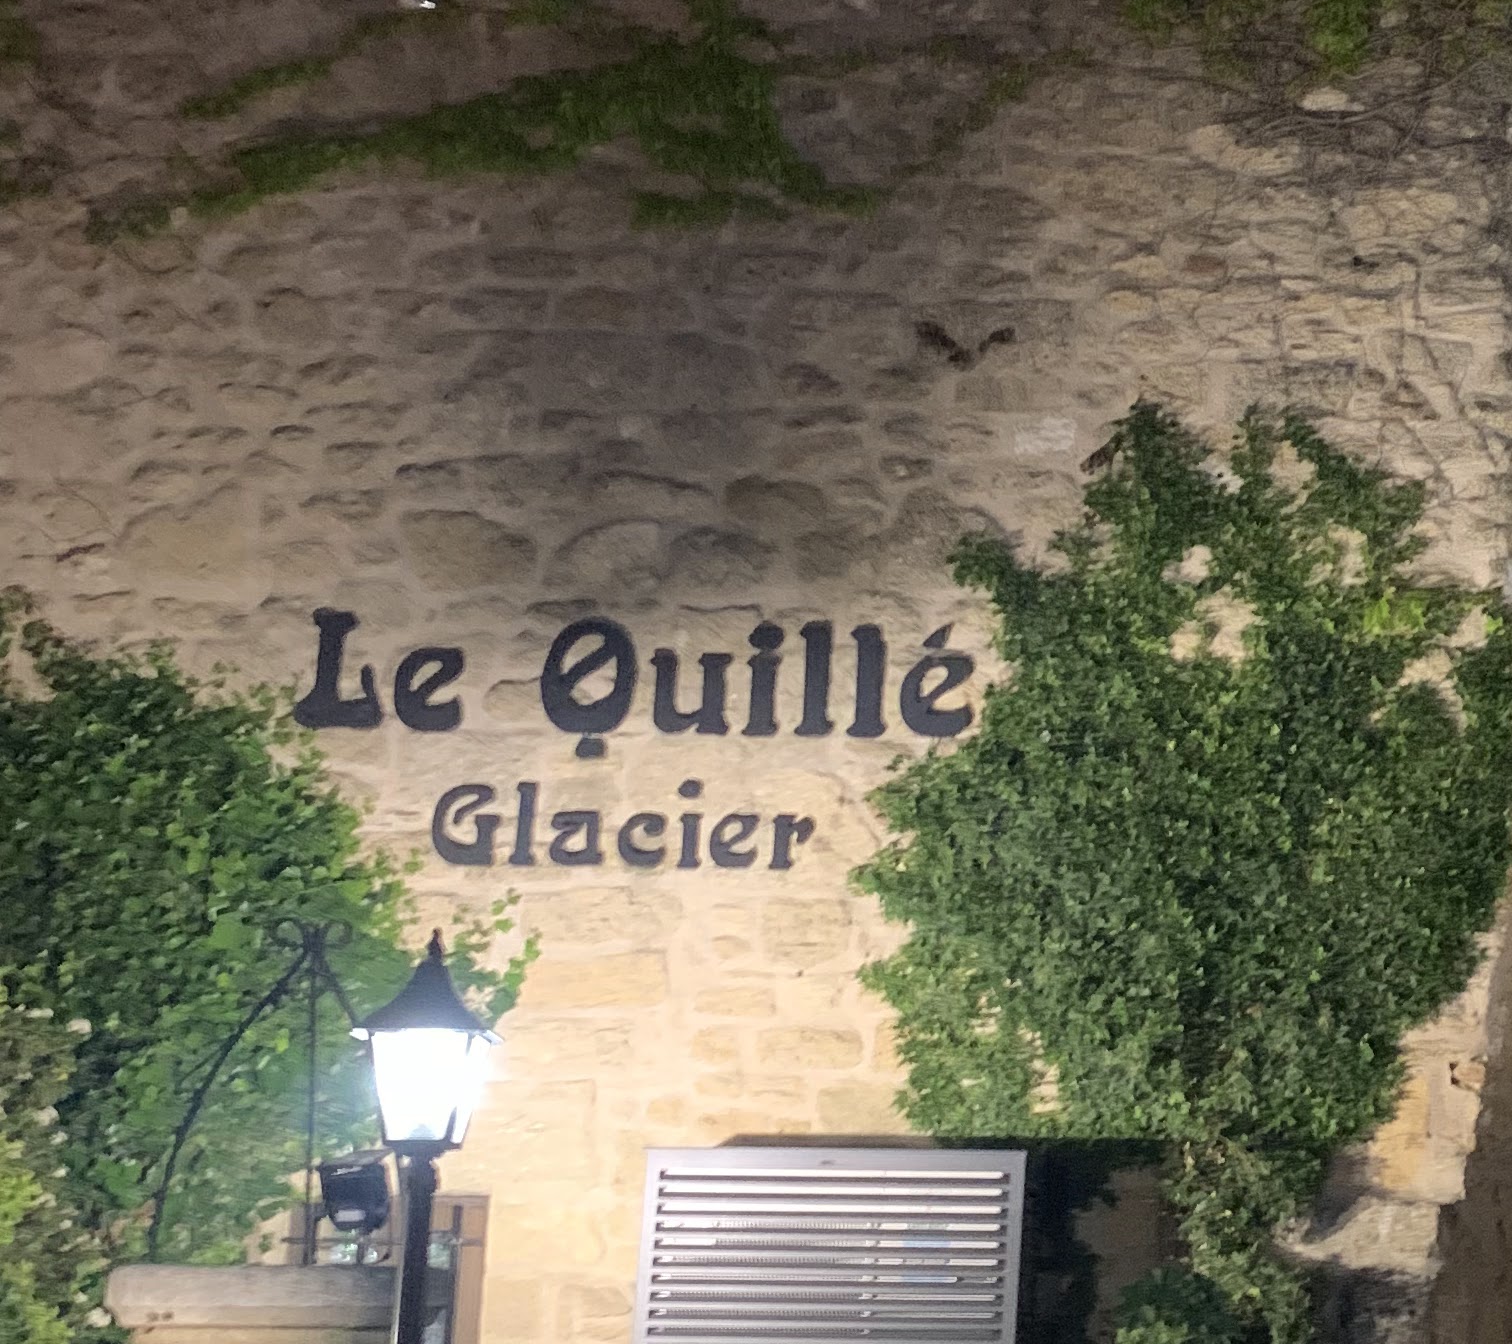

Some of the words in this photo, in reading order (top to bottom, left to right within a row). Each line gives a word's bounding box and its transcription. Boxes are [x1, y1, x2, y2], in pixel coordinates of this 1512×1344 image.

[295, 606, 466, 734] Le
[540, 616, 976, 759] Quillé
[432, 779, 816, 869] Glacier
